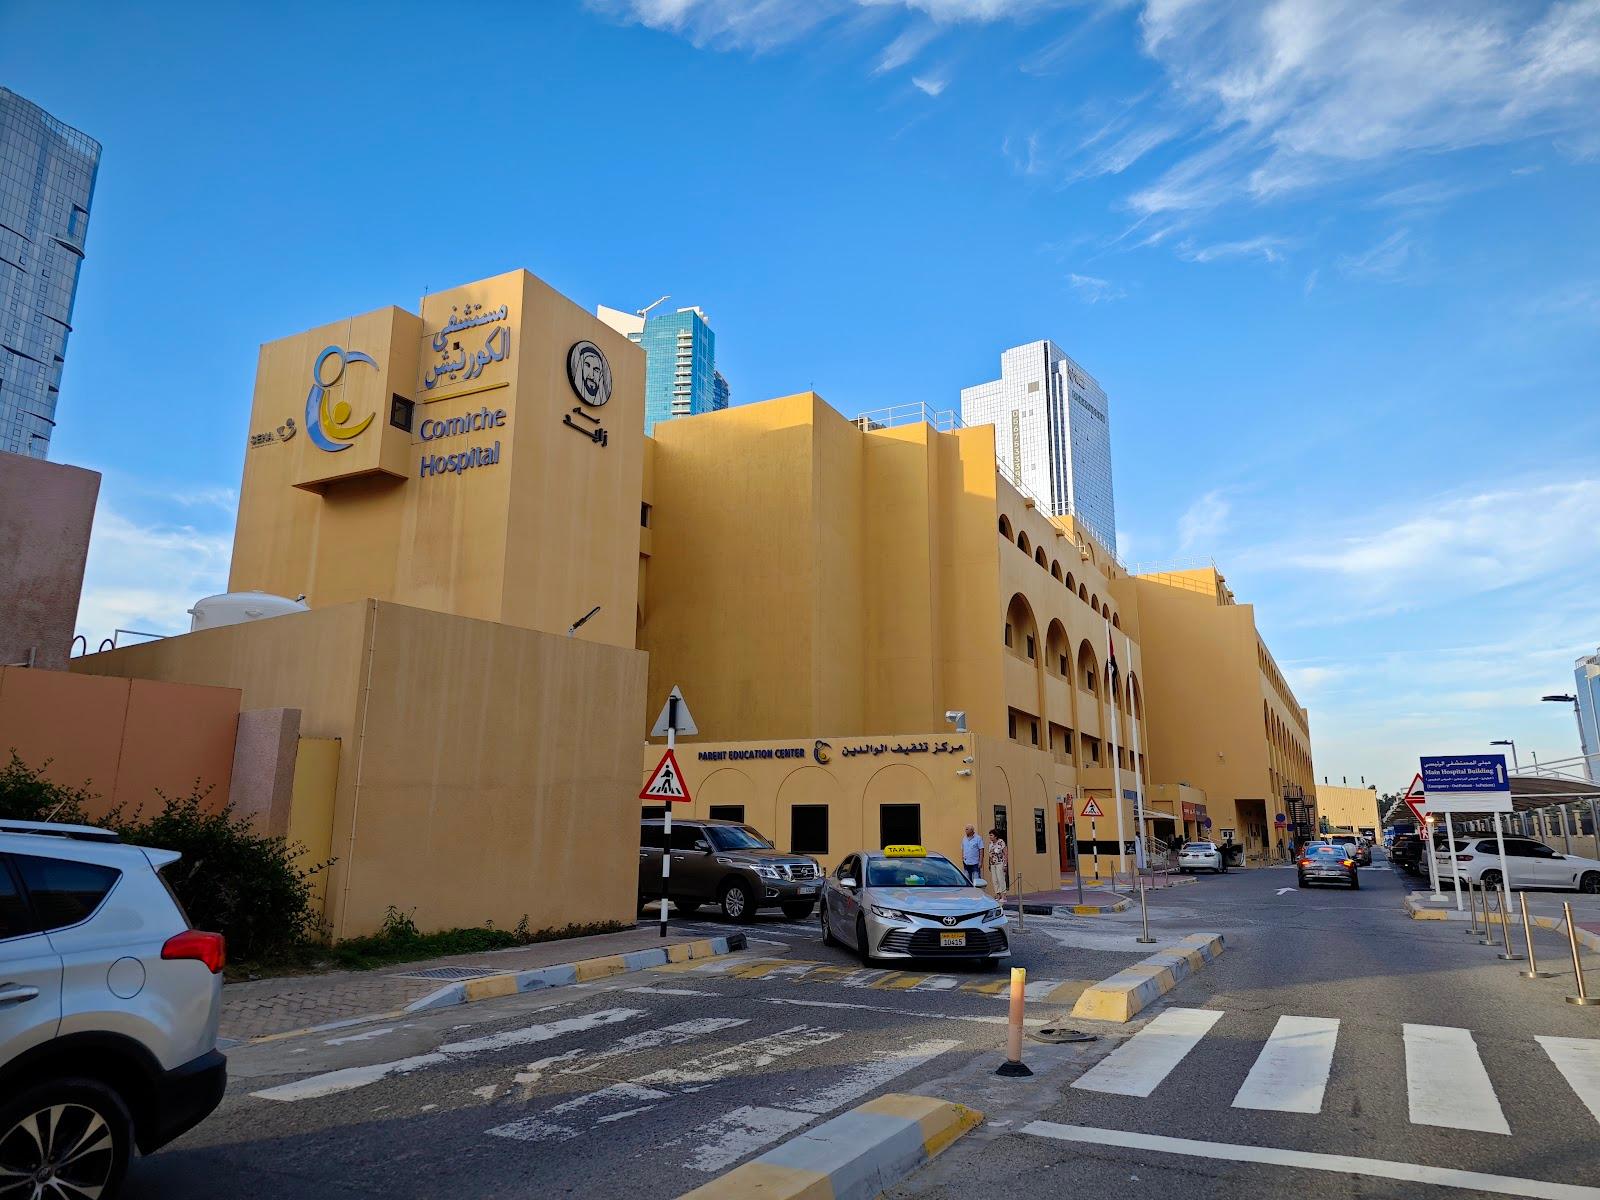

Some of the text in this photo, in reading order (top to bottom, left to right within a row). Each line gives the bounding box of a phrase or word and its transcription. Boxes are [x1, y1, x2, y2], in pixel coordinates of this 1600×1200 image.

[425, 326, 510, 389] الكورنيش
[420, 407, 506, 441] Corniche
[420, 440, 500, 478] Hospital
[698, 748, 805, 760] PARENT EDUCATION CENTER
[842, 742, 964, 757] مركز تثقيف الوالدين
